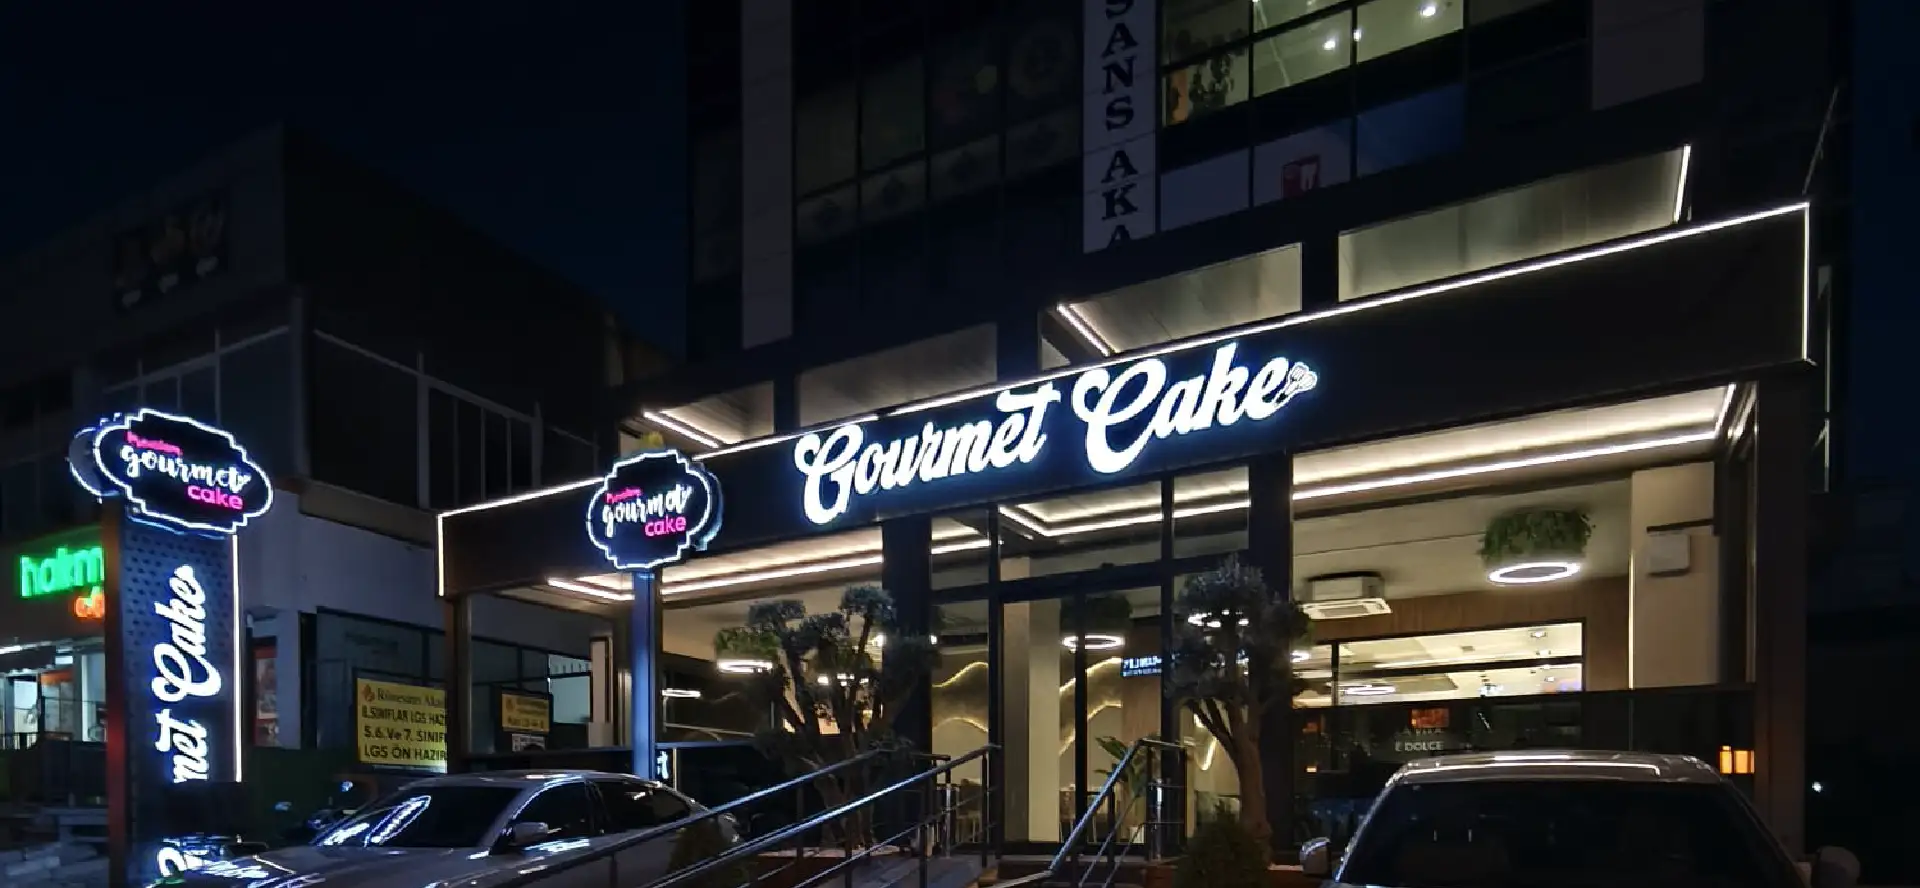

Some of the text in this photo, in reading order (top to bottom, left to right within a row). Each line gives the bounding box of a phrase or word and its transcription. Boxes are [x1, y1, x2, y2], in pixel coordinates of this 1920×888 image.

[793, 342, 1291, 525] Gourmet Cake
[119, 444, 251, 493] gourmet
[187, 484, 244, 510] cake
[602, 483, 694, 538] gourmet
[644, 514, 687, 537] cake
[151, 567, 222, 702] Cake
